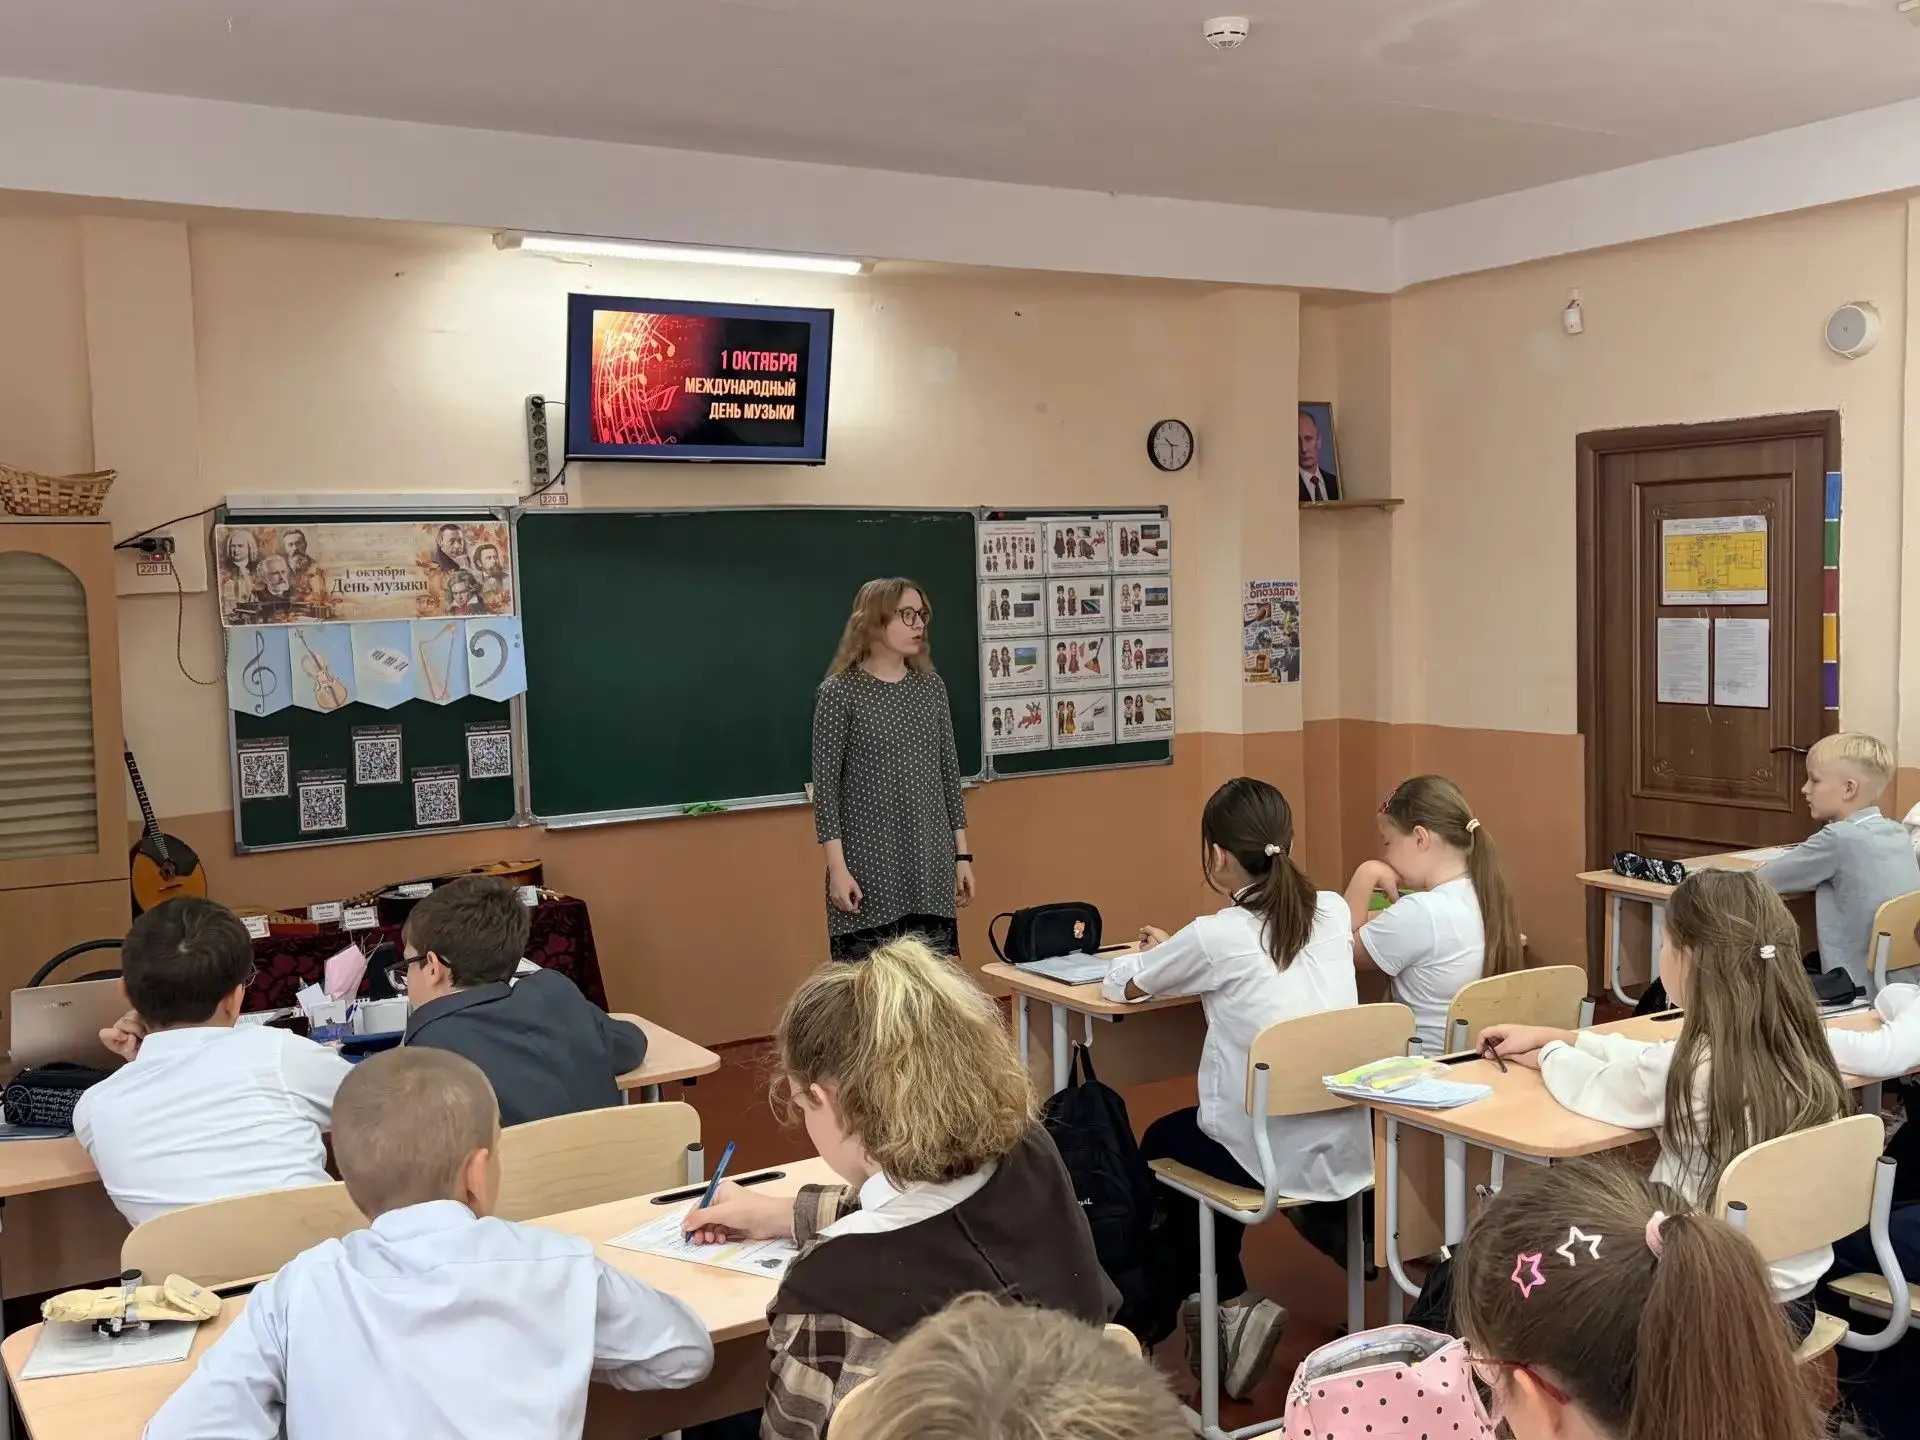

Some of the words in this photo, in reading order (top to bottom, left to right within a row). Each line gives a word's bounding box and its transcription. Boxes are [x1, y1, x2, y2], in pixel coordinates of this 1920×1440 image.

[721, 350, 728, 370] 1
[732, 350, 798, 372] ОКТЯБРЯ
[684, 377, 797, 398] МЕЖДУНАРОДНЫЙ
[709, 402, 742, 420] ДЕНЬ
[743, 403, 795, 420] МУЗЫКИ
[140, 565, 158, 573] 220
[345, 568, 350, 579] 1
[356, 566, 406, 580] октября
[331, 579, 370, 596] День
[373, 581, 428, 596] музыки
